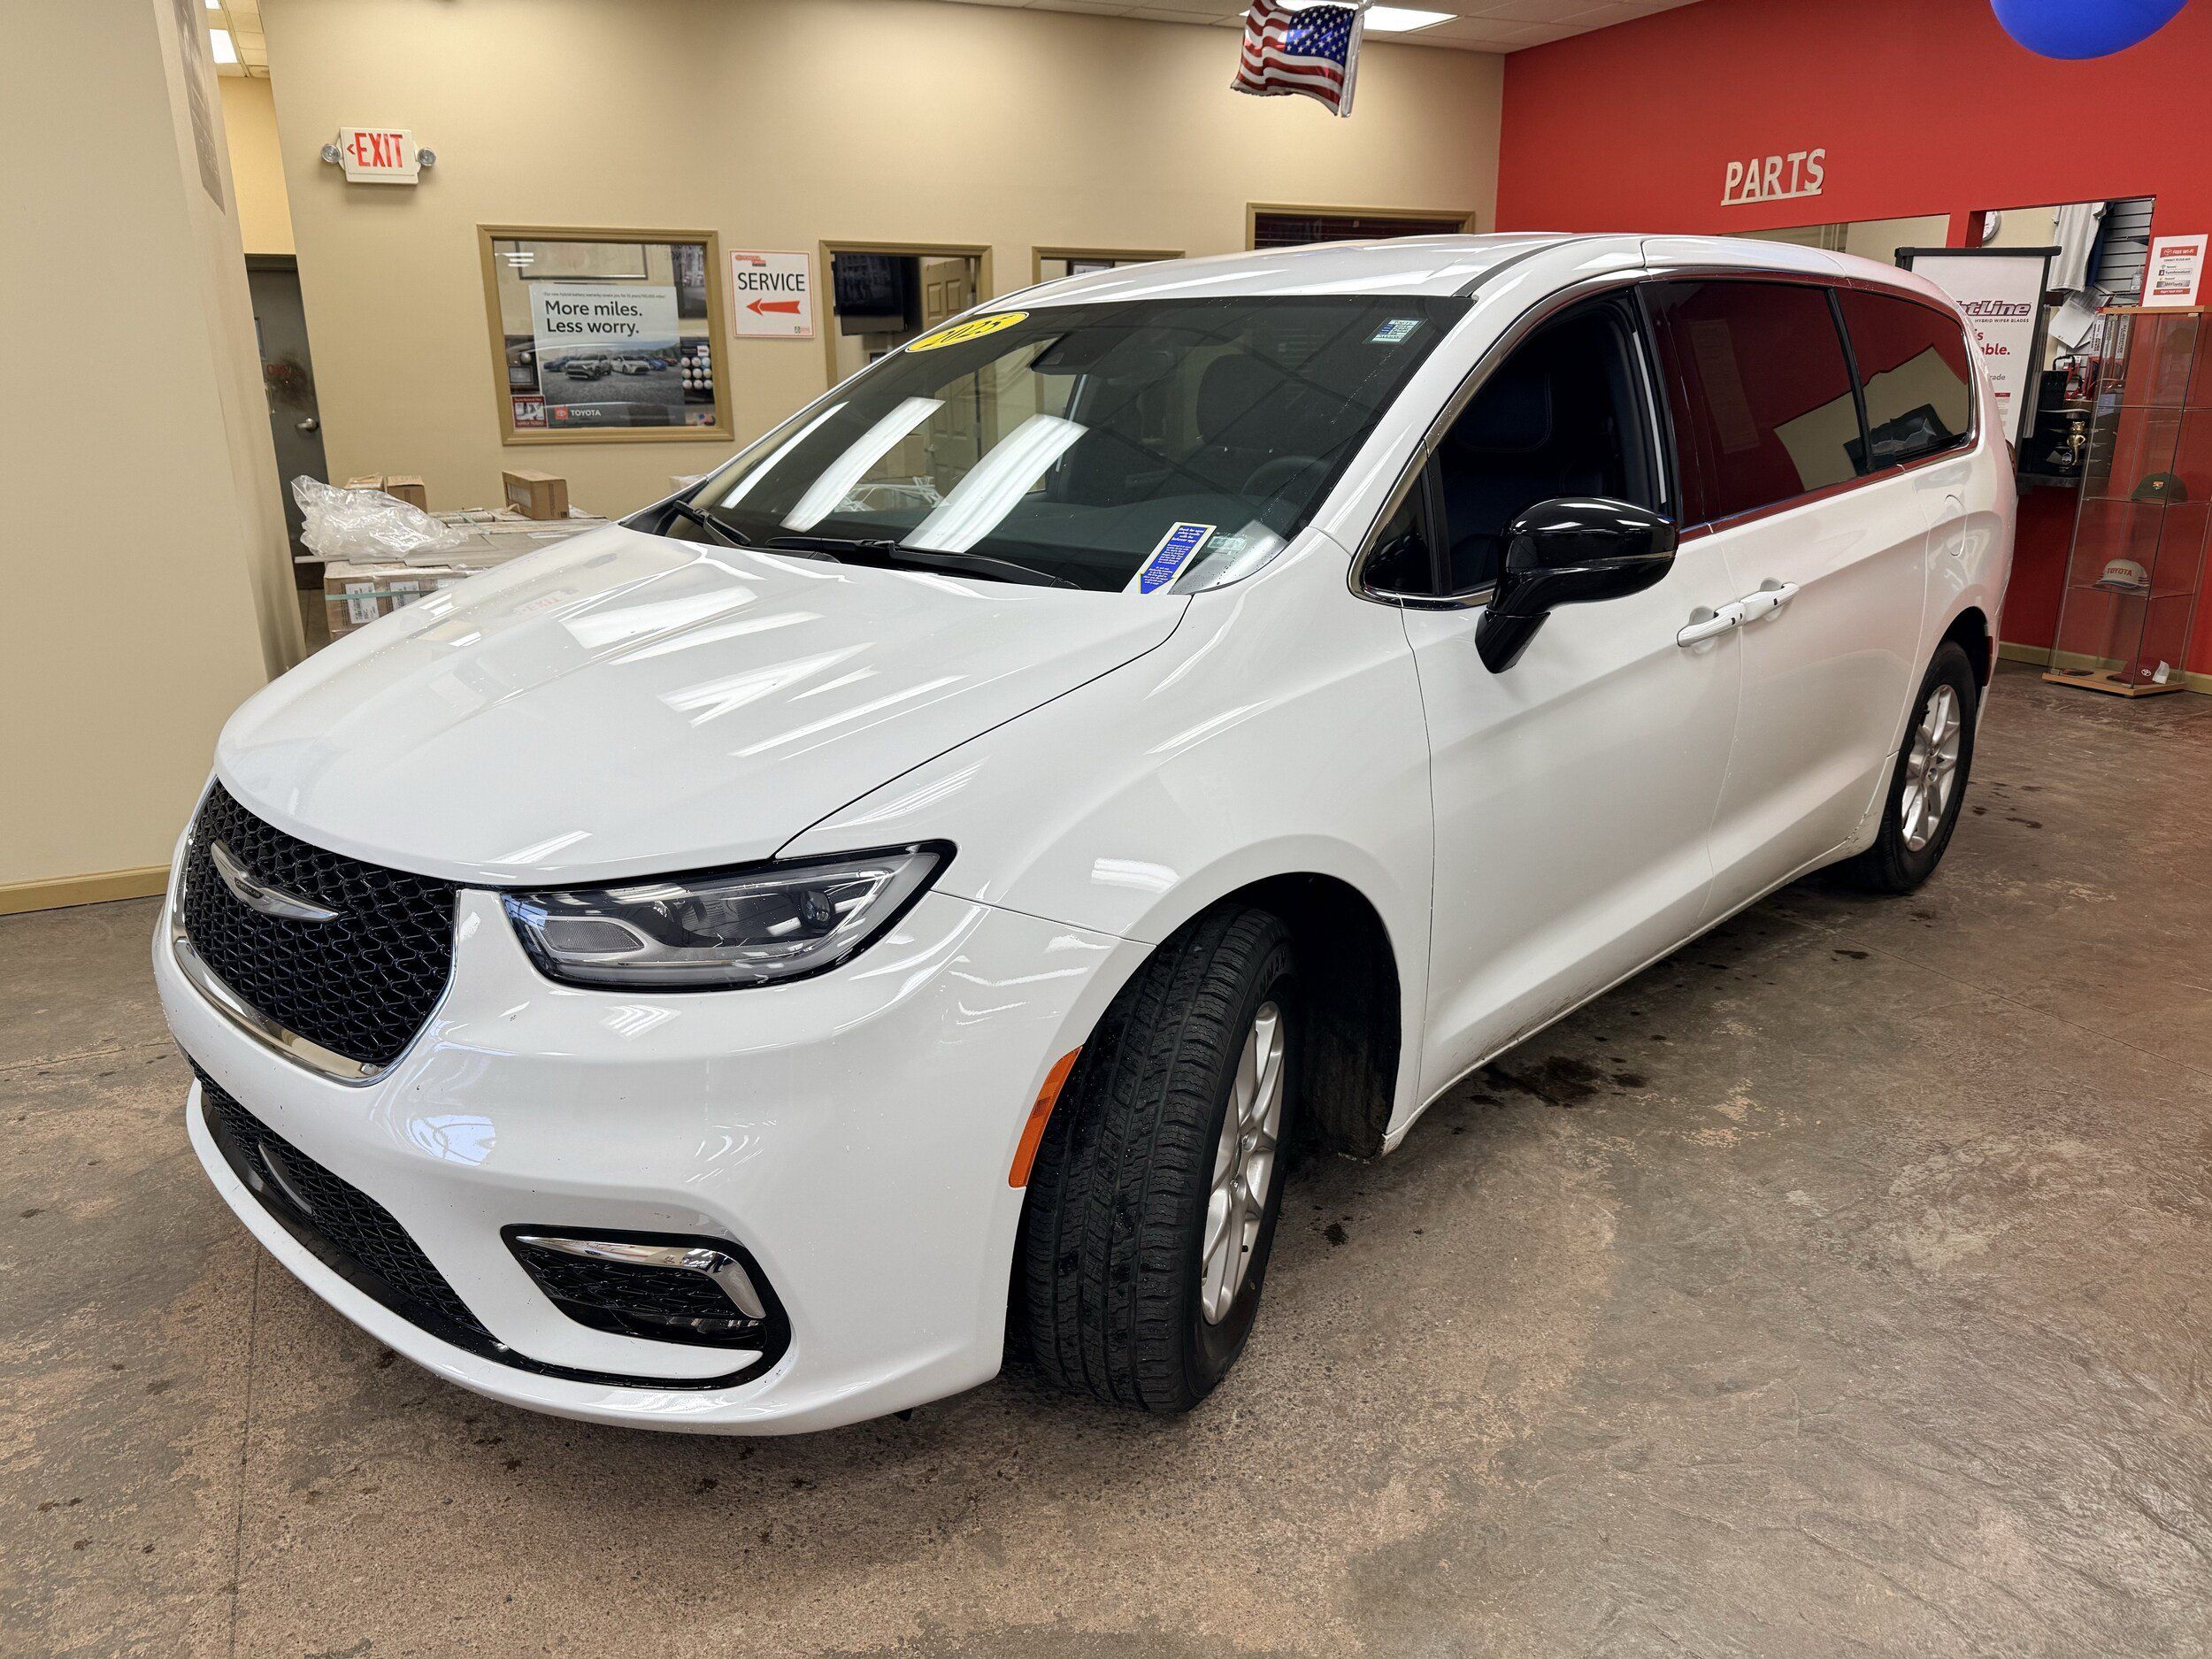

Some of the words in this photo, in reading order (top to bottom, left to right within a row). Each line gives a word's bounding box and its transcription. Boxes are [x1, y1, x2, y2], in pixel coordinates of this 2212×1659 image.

[354, 132, 403, 168] EXIT
[1724, 148, 1826, 201] PARTS
[737, 272, 805, 291] SERVICE
[545, 300, 589, 315] More
[595, 301, 642, 317] miles.
[547, 318, 583, 333] Less
[588, 321, 640, 337] worry.
[920, 315, 1015, 349] 2025
[2107, 567, 2132, 576] TOYOTA
